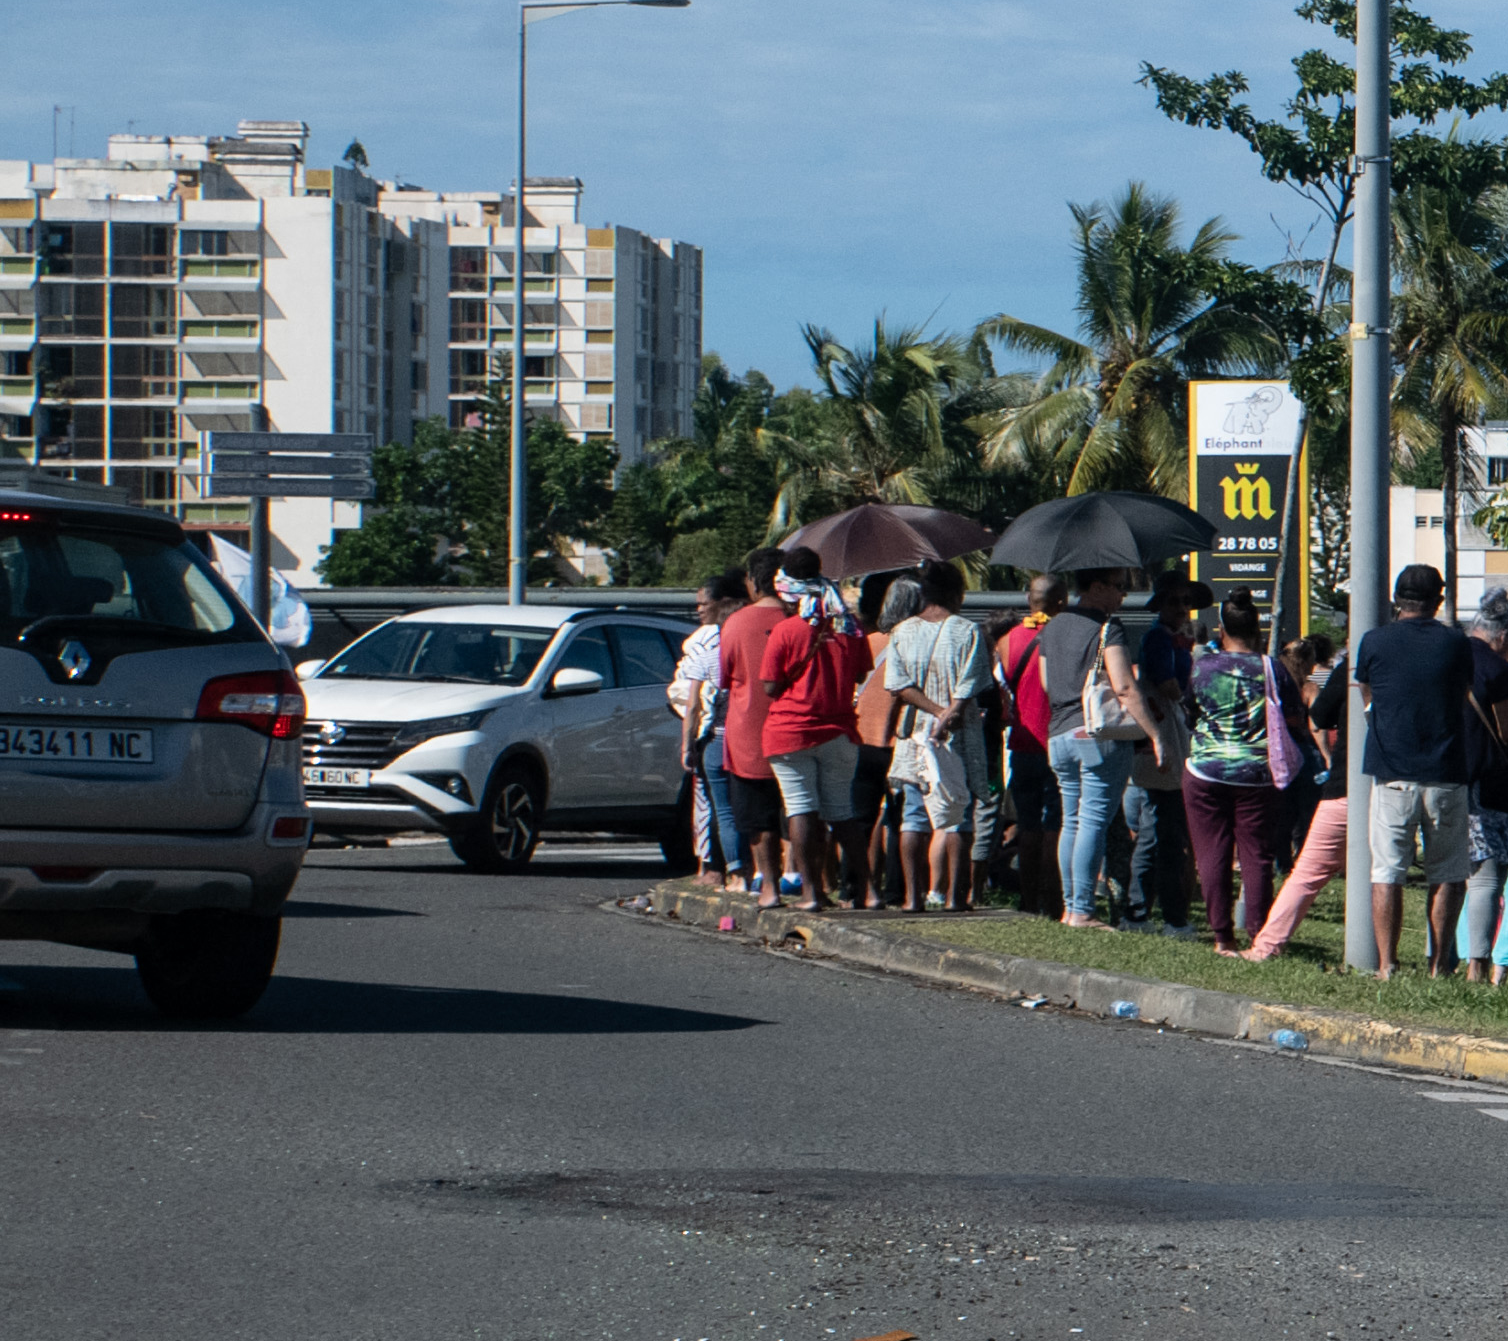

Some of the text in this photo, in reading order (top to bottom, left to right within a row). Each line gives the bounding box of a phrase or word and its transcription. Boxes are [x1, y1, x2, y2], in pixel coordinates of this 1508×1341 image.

[1205, 438, 1262, 451] Eléphant
[1218, 537, 1277, 550] 28 78 05
[1229, 563, 1266, 572] VIDANGE
[109, 732, 142, 759] NC
